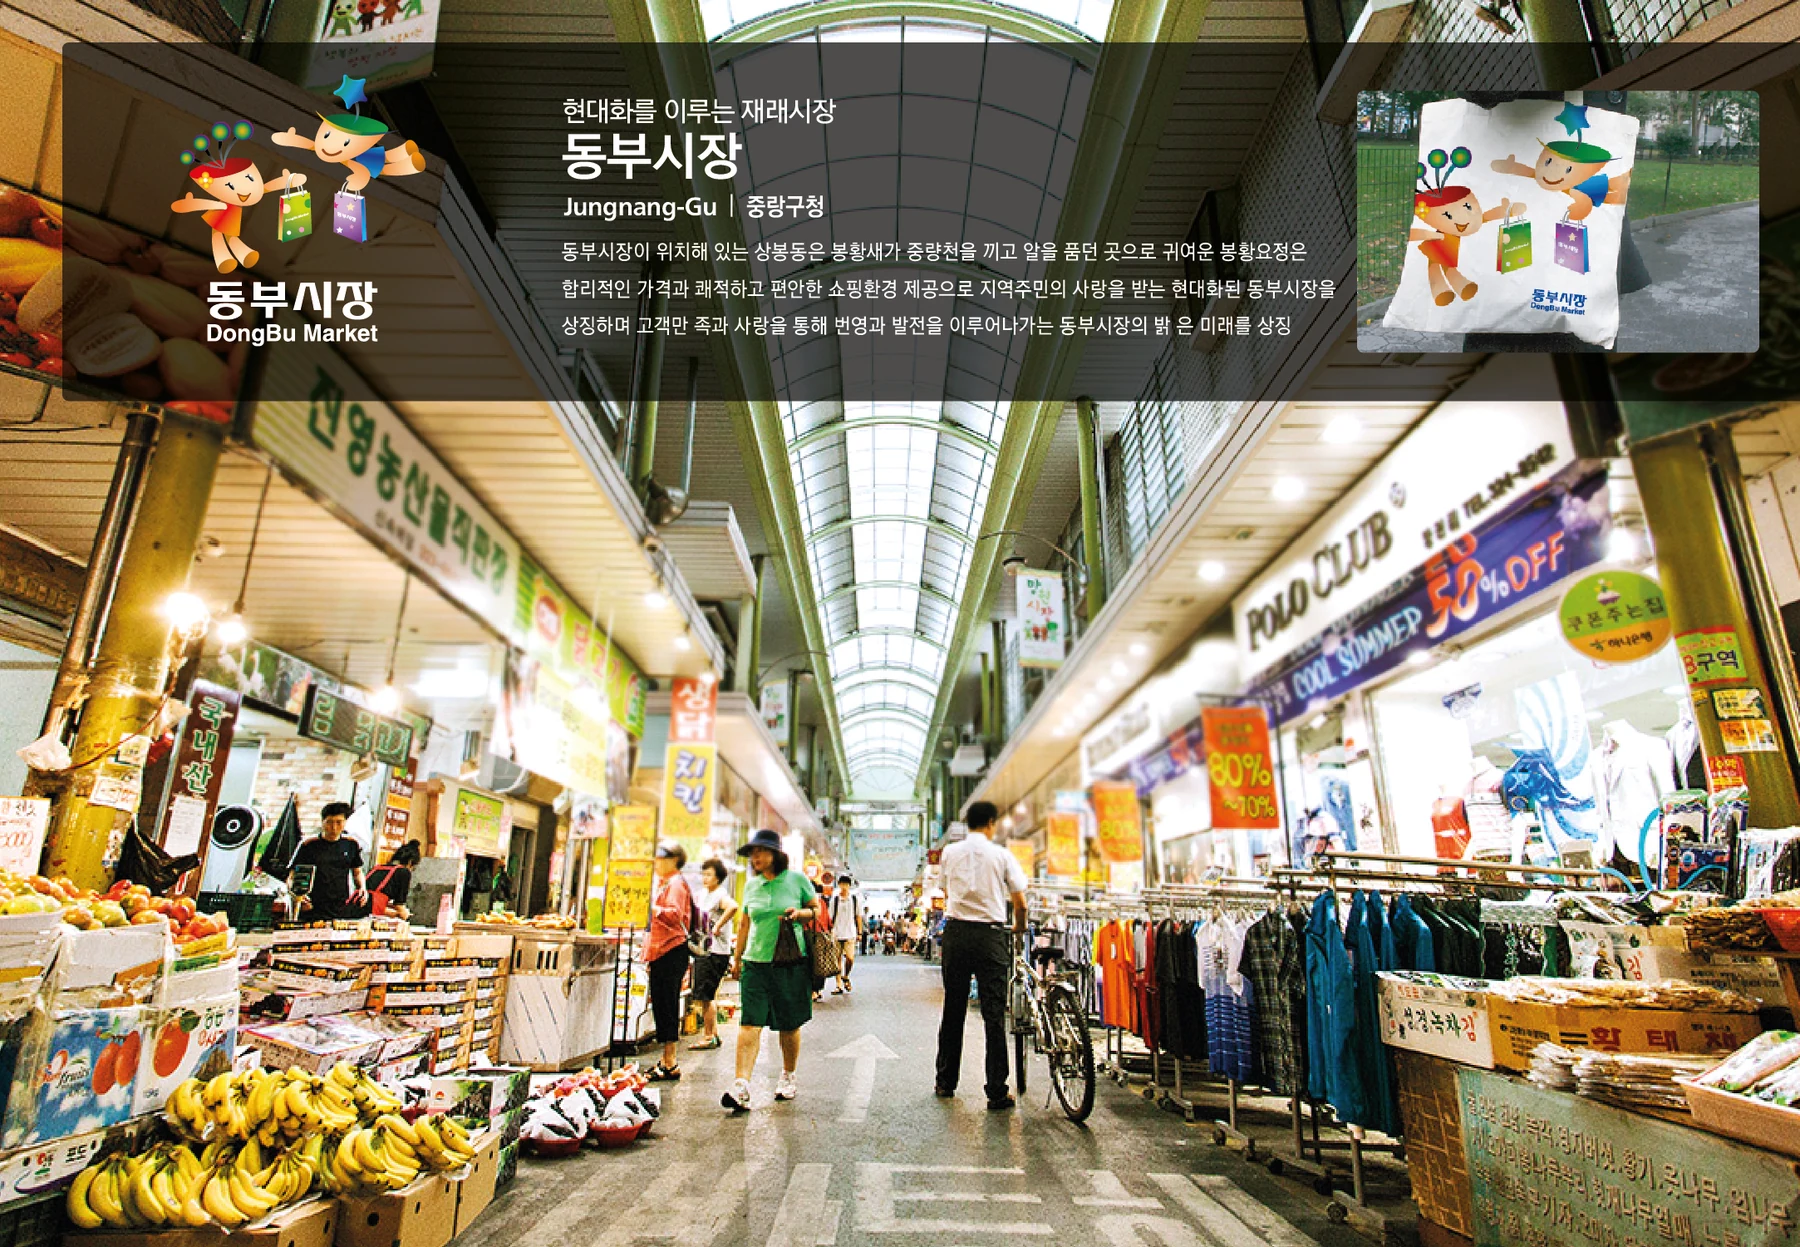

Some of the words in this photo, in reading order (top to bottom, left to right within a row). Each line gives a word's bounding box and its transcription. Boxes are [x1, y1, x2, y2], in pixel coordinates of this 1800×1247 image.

[1530, 302, 1560, 311] DongBu
[1561, 306, 1586, 315] Market
[1532, 288, 1587, 308] 동부시장
[1247, 578, 1309, 652] POLO
[1311, 510, 1393, 598] CLUB
[1292, 652, 1339, 699] COOL
[1336, 605, 1423, 677] SUMMER
[182, 696, 227, 794] 국내산
[1208, 751, 1272, 788] 80%
[674, 749, 708, 814] 치킨
